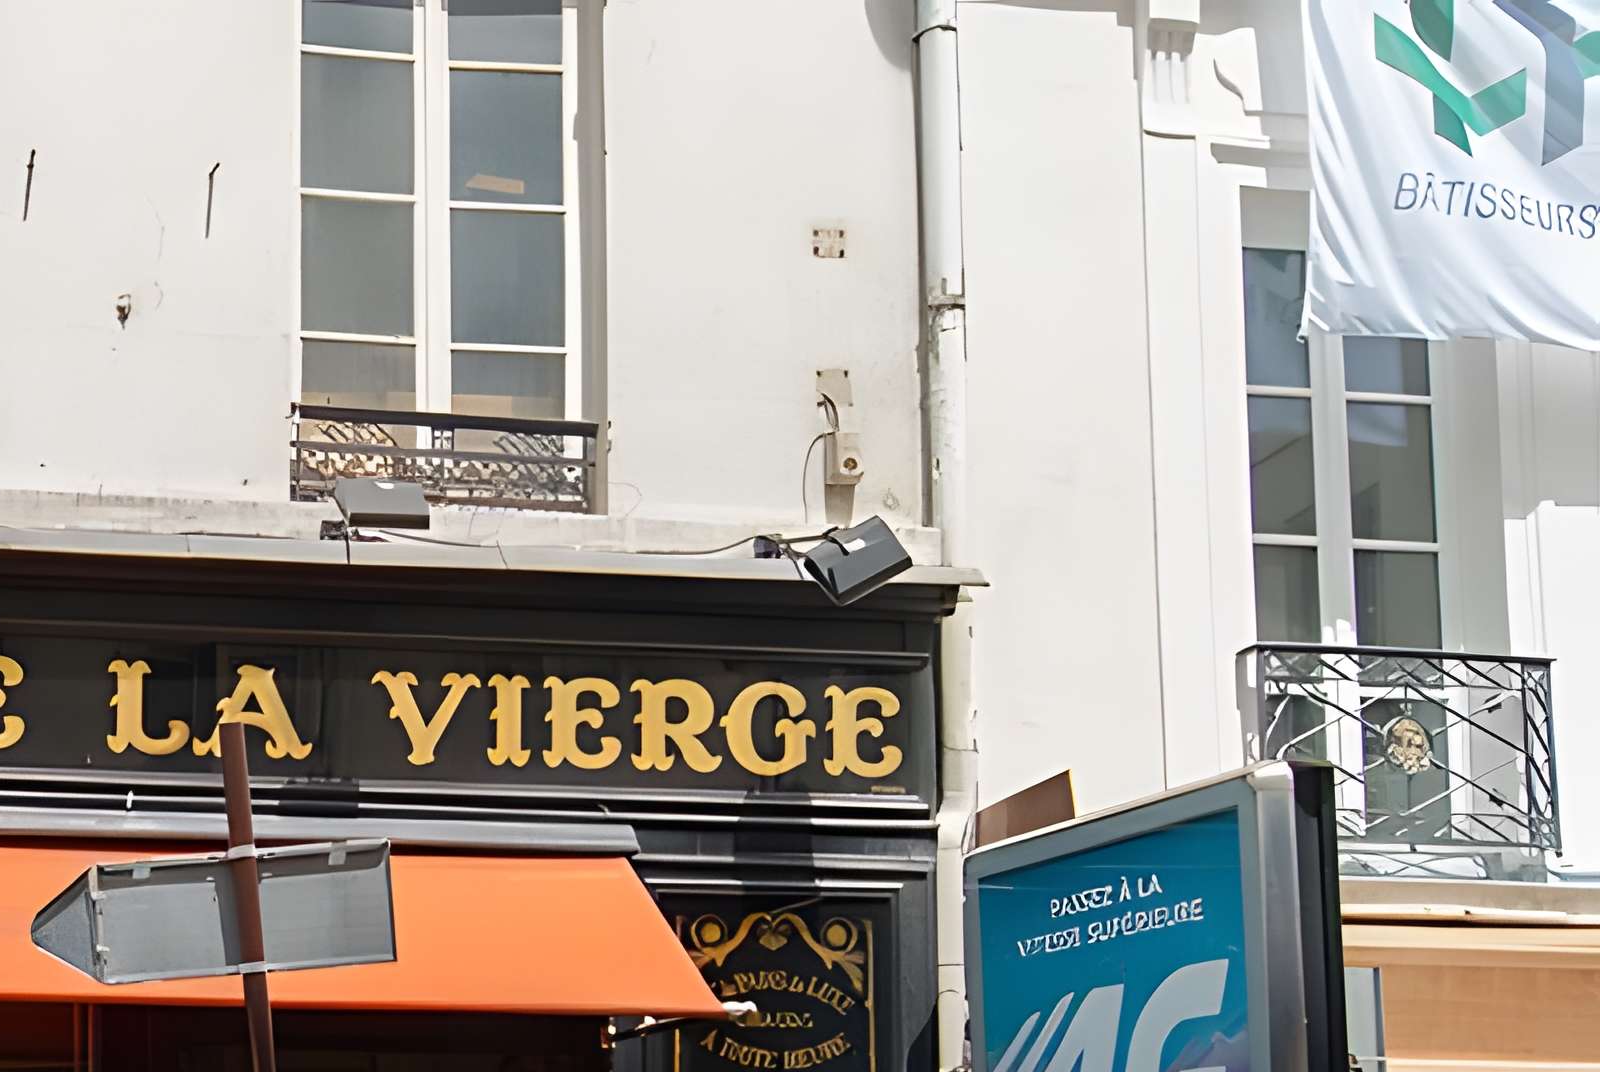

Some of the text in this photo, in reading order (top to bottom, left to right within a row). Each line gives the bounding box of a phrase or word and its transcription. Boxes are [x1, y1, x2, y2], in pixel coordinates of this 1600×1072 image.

[1393, 172, 1599, 239] BÂTISSEURS
[106, 659, 312, 760] LA
[371, 670, 903, 778] VIERGE
